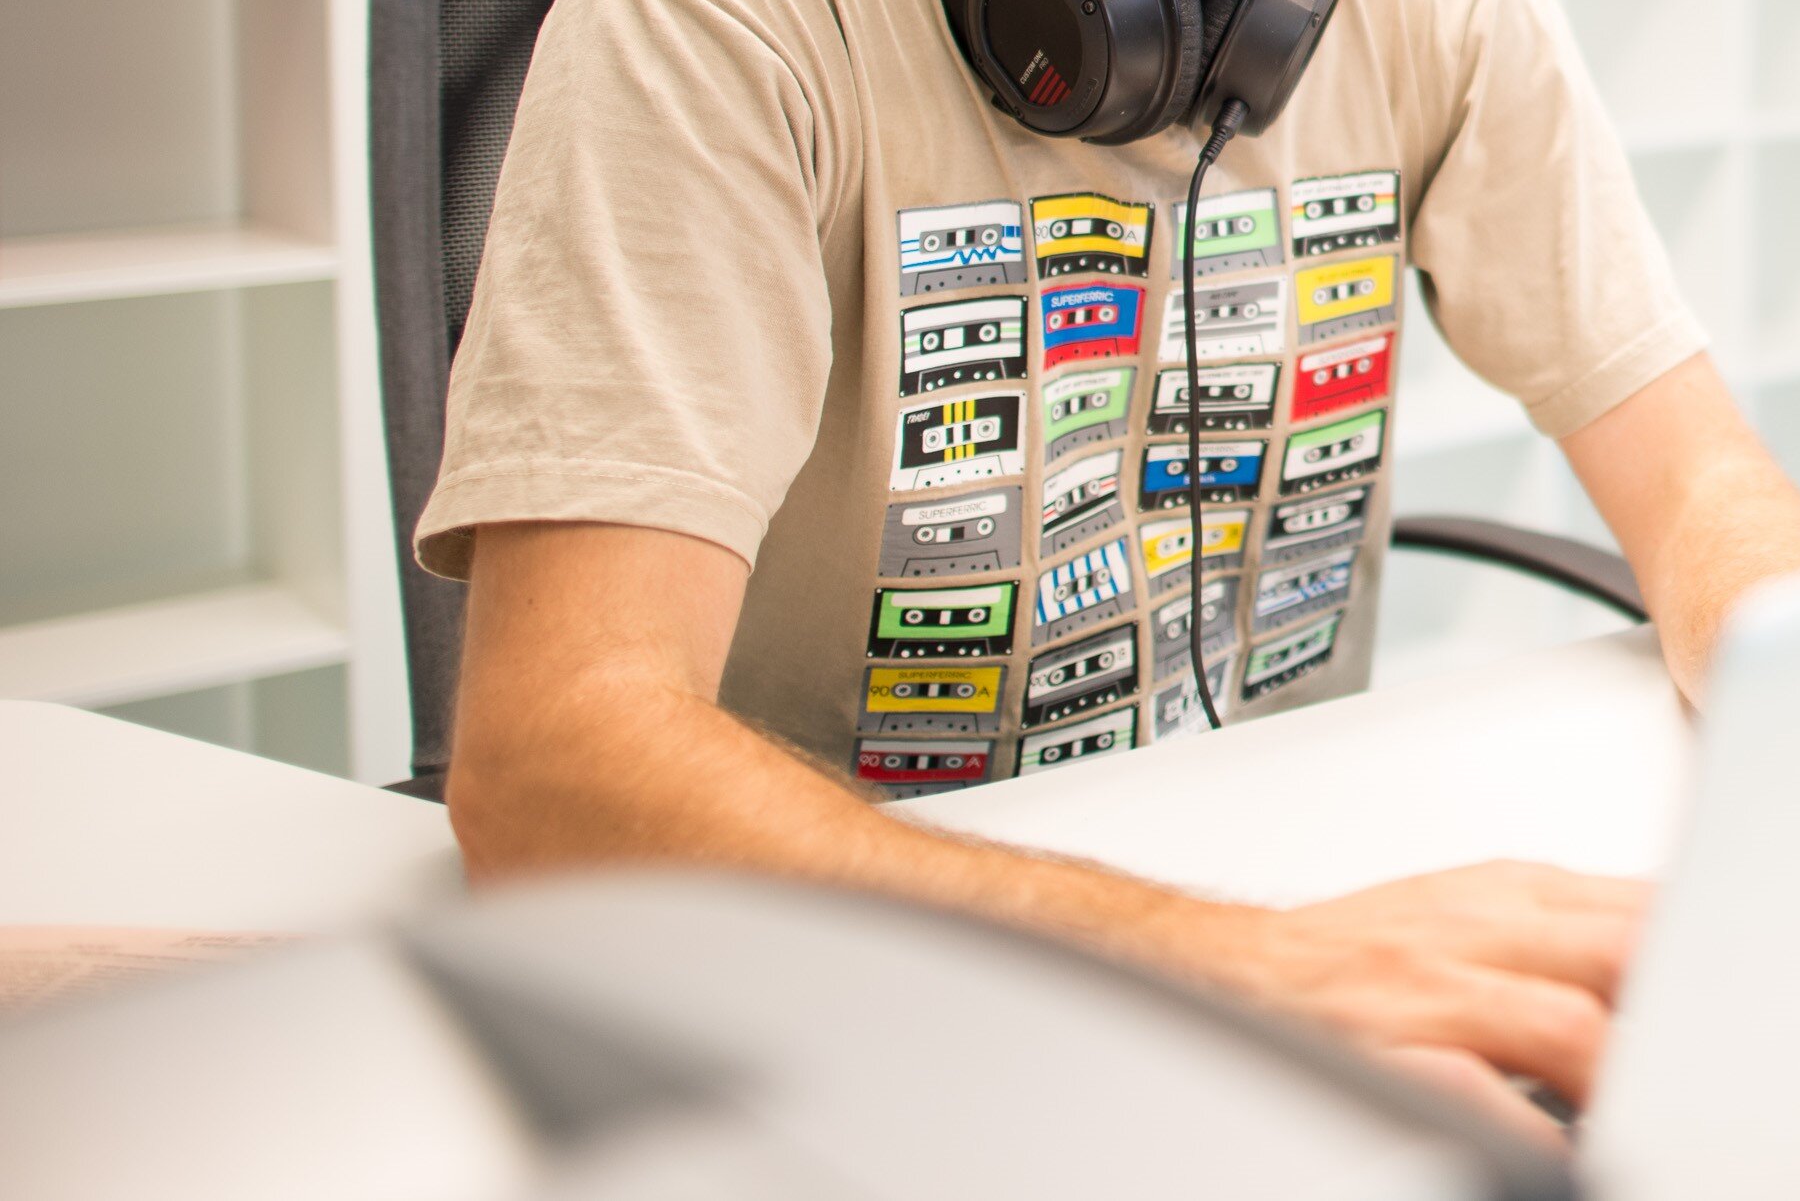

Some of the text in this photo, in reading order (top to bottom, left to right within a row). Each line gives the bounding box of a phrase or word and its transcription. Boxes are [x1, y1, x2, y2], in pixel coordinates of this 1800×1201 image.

[1020, 48, 1044, 85] CUSTOM ONE
[1125, 230, 1138, 242] A
[1051, 291, 1114, 307] SUPERFERRIC
[919, 501, 987, 520] SUPERFERRIC
[898, 671, 972, 680] SUPERFERRIC
[870, 685, 991, 697] 90 A
[859, 754, 981, 768] 90 A
